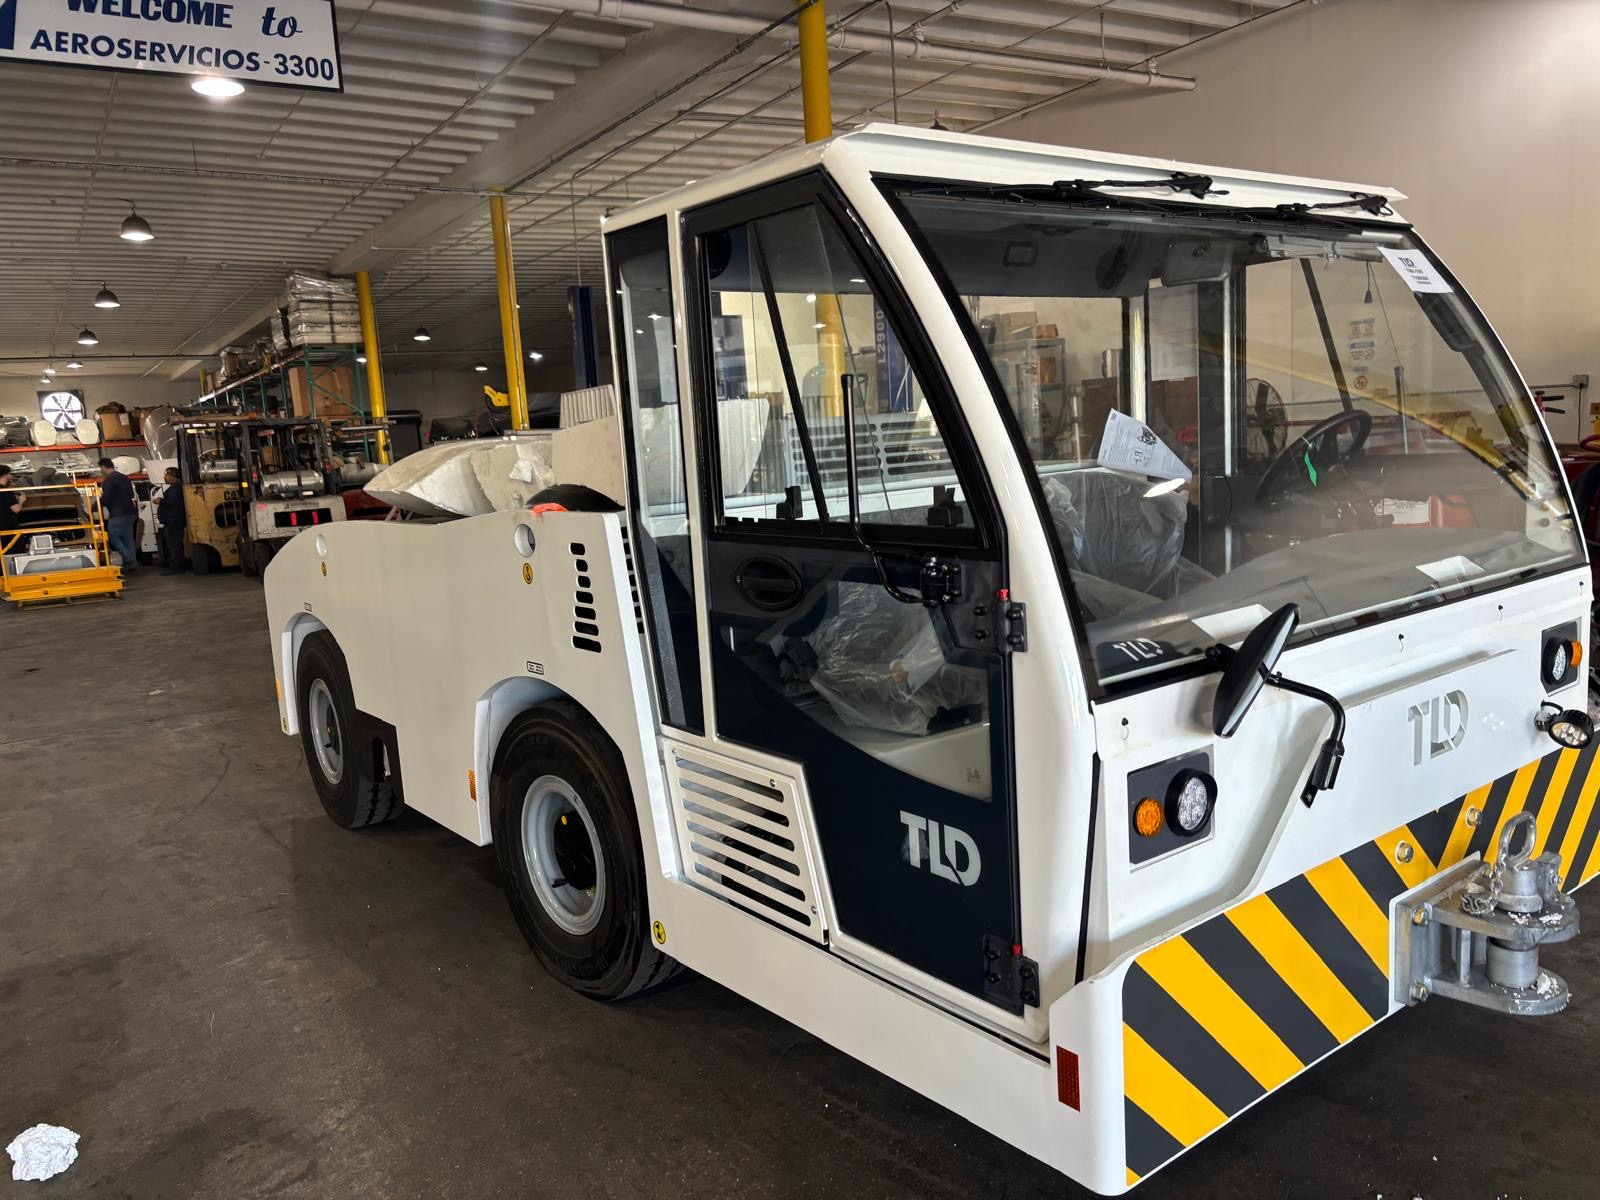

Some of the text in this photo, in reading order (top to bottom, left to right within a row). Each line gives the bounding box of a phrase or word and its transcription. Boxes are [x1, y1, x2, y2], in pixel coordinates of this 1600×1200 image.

[67, 0, 304, 38] WELCOME to
[1407, 689, 1469, 767] TLD
[899, 809, 982, 887] TLD
